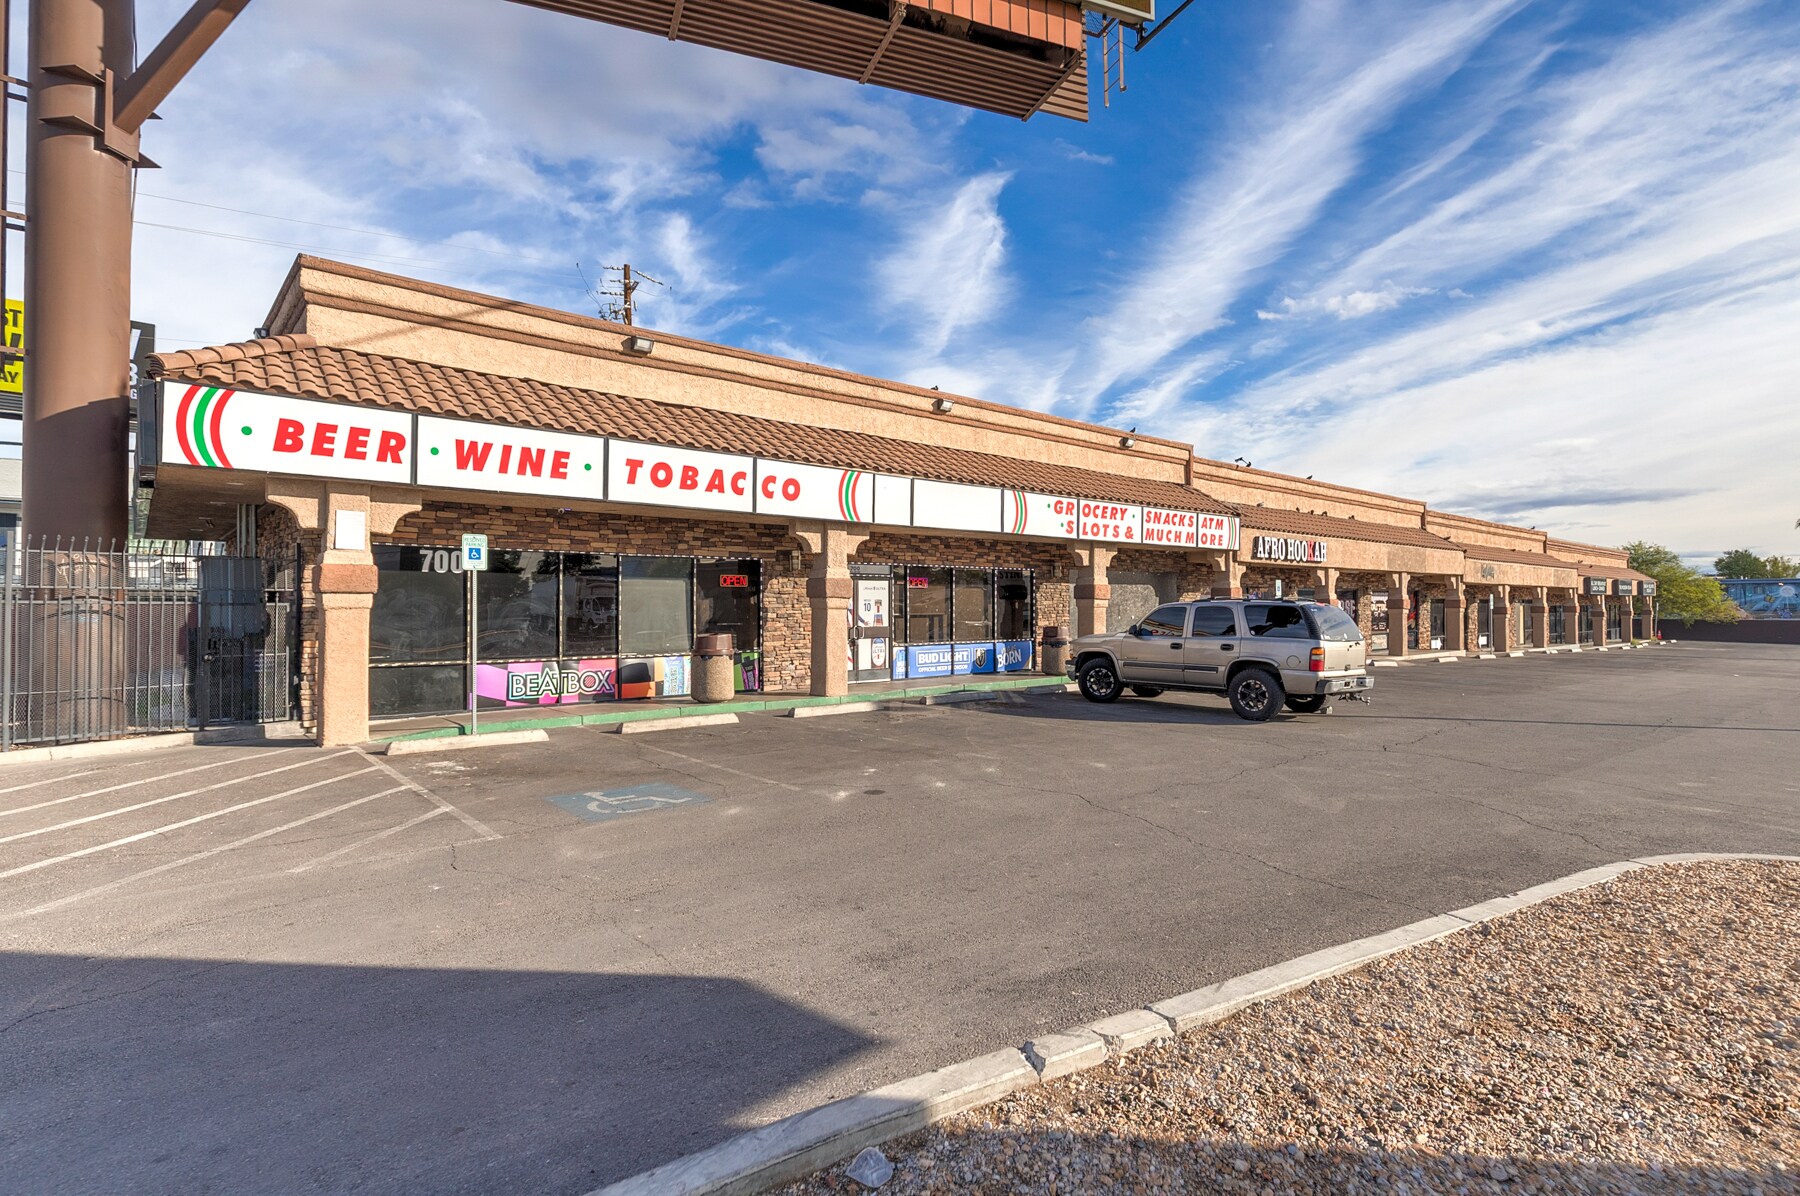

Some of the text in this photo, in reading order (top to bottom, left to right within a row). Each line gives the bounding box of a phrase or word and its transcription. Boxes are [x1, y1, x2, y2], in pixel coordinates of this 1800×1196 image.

[273, 418, 406, 464] BEER
[455, 439, 571, 480] WINE
[625, 458, 801, 502] TOBACCO
[1053, 500, 1223, 531] GROCERY SNACKS ATM
[1066, 520, 1224, 547] SLOTS & MUCH MORE
[419, 549, 463, 574] 700
[1257, 536, 1327, 562] AFRO HOOKAH
[721, 575, 747, 587] OPEN
[909, 578, 927, 588] OPEN
[864, 602, 871, 612] 10
[918, 652, 939, 664] BUD
[997, 649, 1022, 668] BORN
[511, 668, 612, 697] BEATBOX
